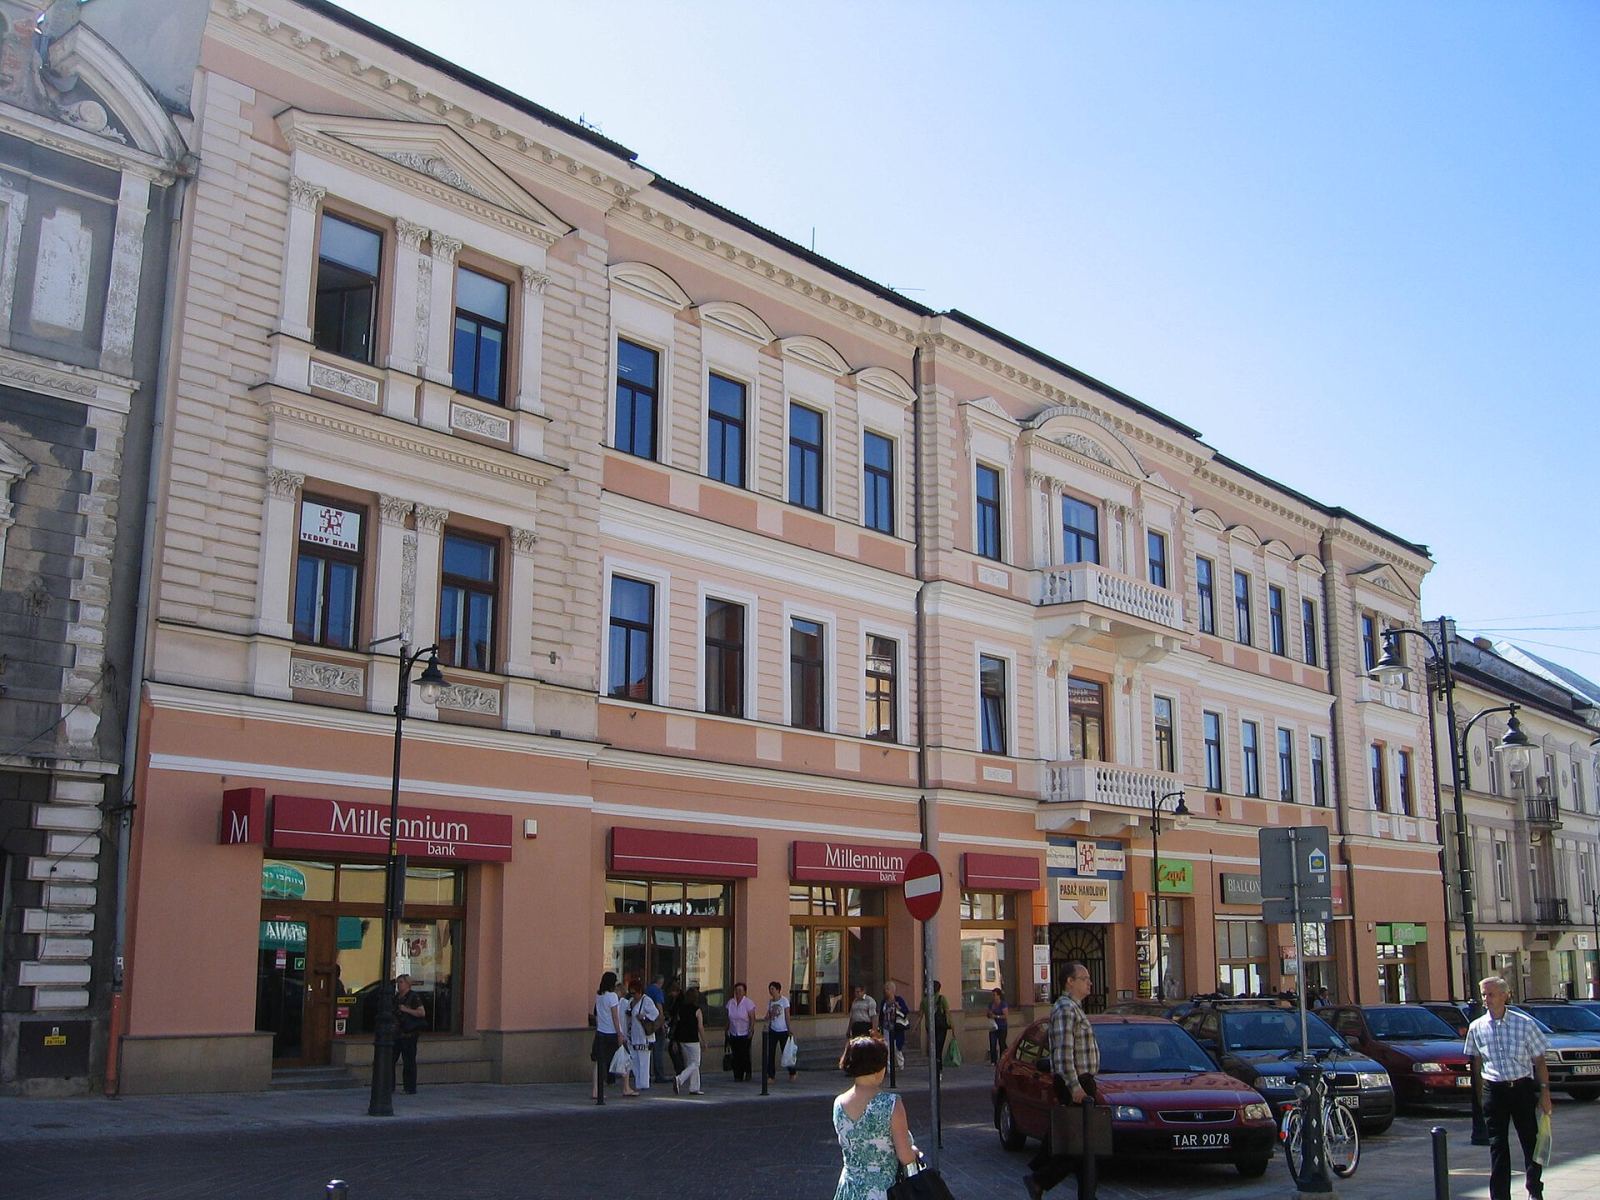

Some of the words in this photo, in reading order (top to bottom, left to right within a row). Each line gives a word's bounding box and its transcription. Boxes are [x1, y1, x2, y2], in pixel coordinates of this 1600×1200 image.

[302, 532, 329, 544] TEDDY
[332, 538, 356, 550] BEAR
[229, 810, 248, 844] M
[330, 800, 468, 841] Millennium
[427, 841, 456, 856] bank
[825, 843, 903, 871] Millennium
[879, 870, 897, 882] bank
[1173, 1134, 1198, 1146] TAR
[1202, 1133, 1230, 1145] 9078
